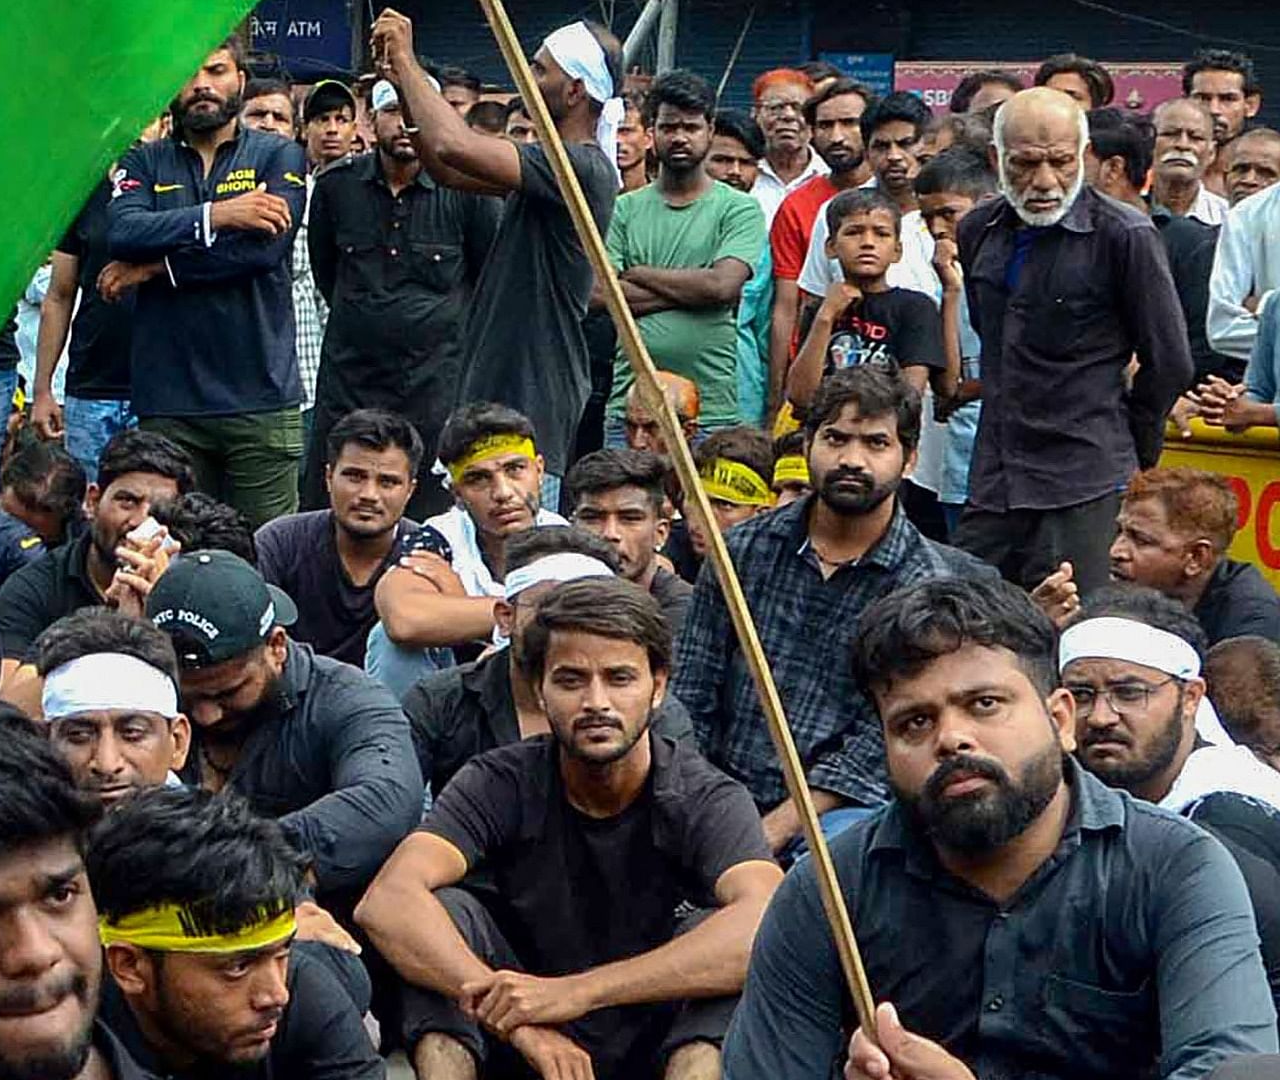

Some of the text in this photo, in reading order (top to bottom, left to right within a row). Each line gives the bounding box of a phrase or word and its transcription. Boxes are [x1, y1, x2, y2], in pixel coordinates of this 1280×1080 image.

[287, 21, 321, 37] ATM
[226, 169, 256, 181] AGM
[216, 180, 259, 195] BHOPA
[177, 609, 220, 641] POLICE
